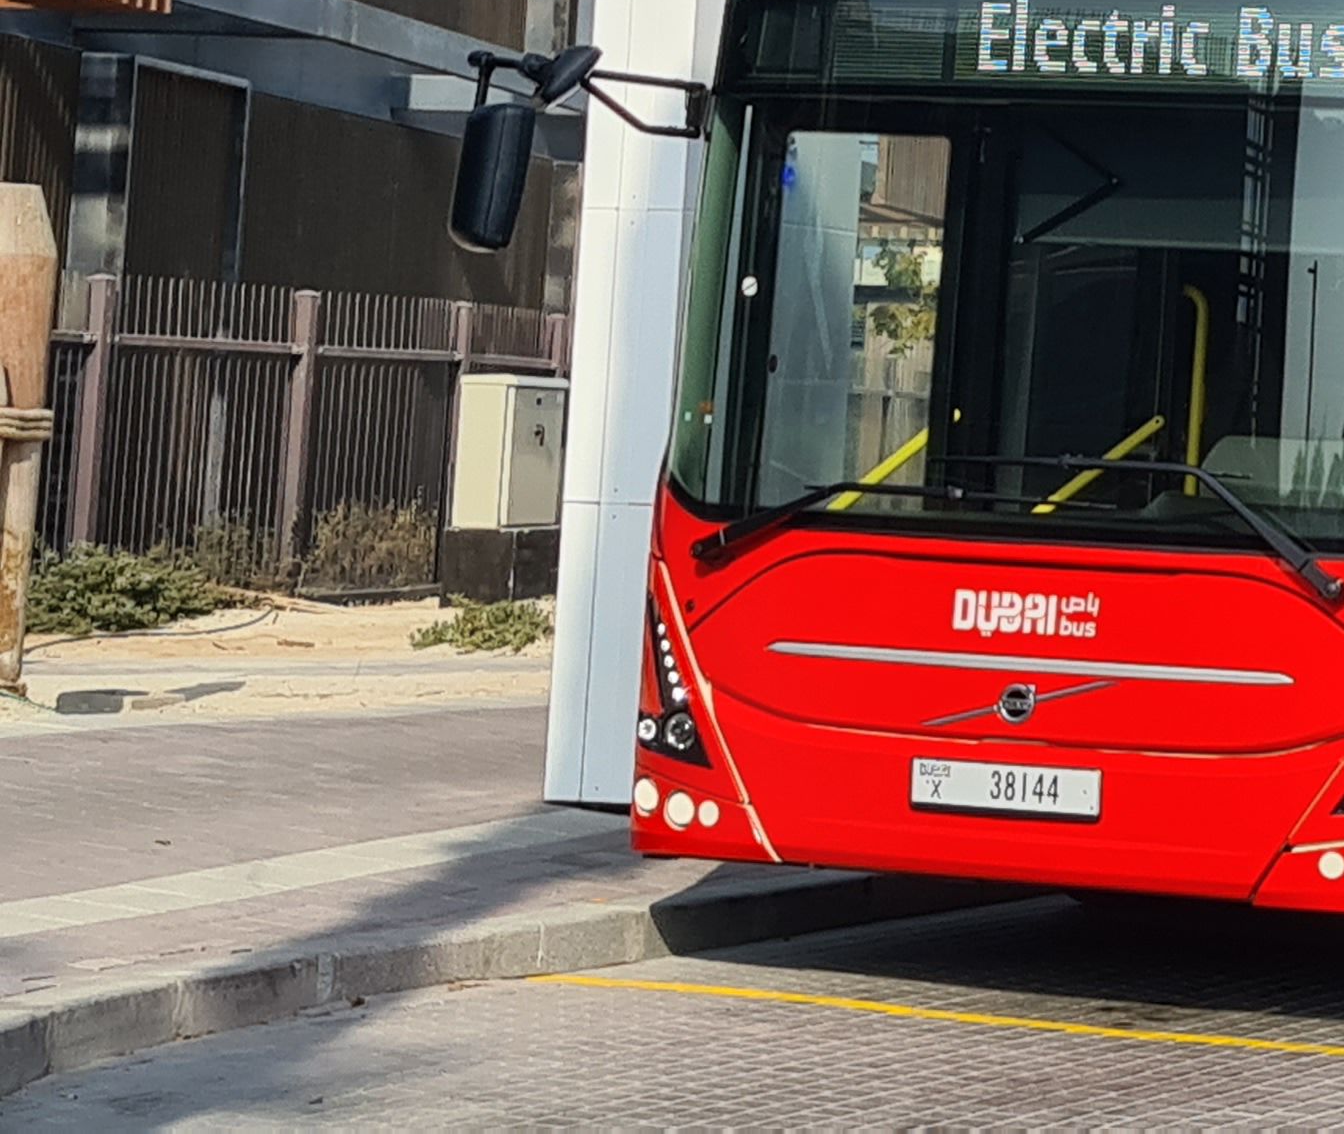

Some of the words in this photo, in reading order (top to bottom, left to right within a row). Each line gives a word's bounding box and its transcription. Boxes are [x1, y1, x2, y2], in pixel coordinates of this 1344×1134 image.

[952, 588, 1058, 637] DUBAI
[1059, 615, 1096, 637] bus
[930, 779, 942, 799] X
[990, 770, 1059, 805] 38144
